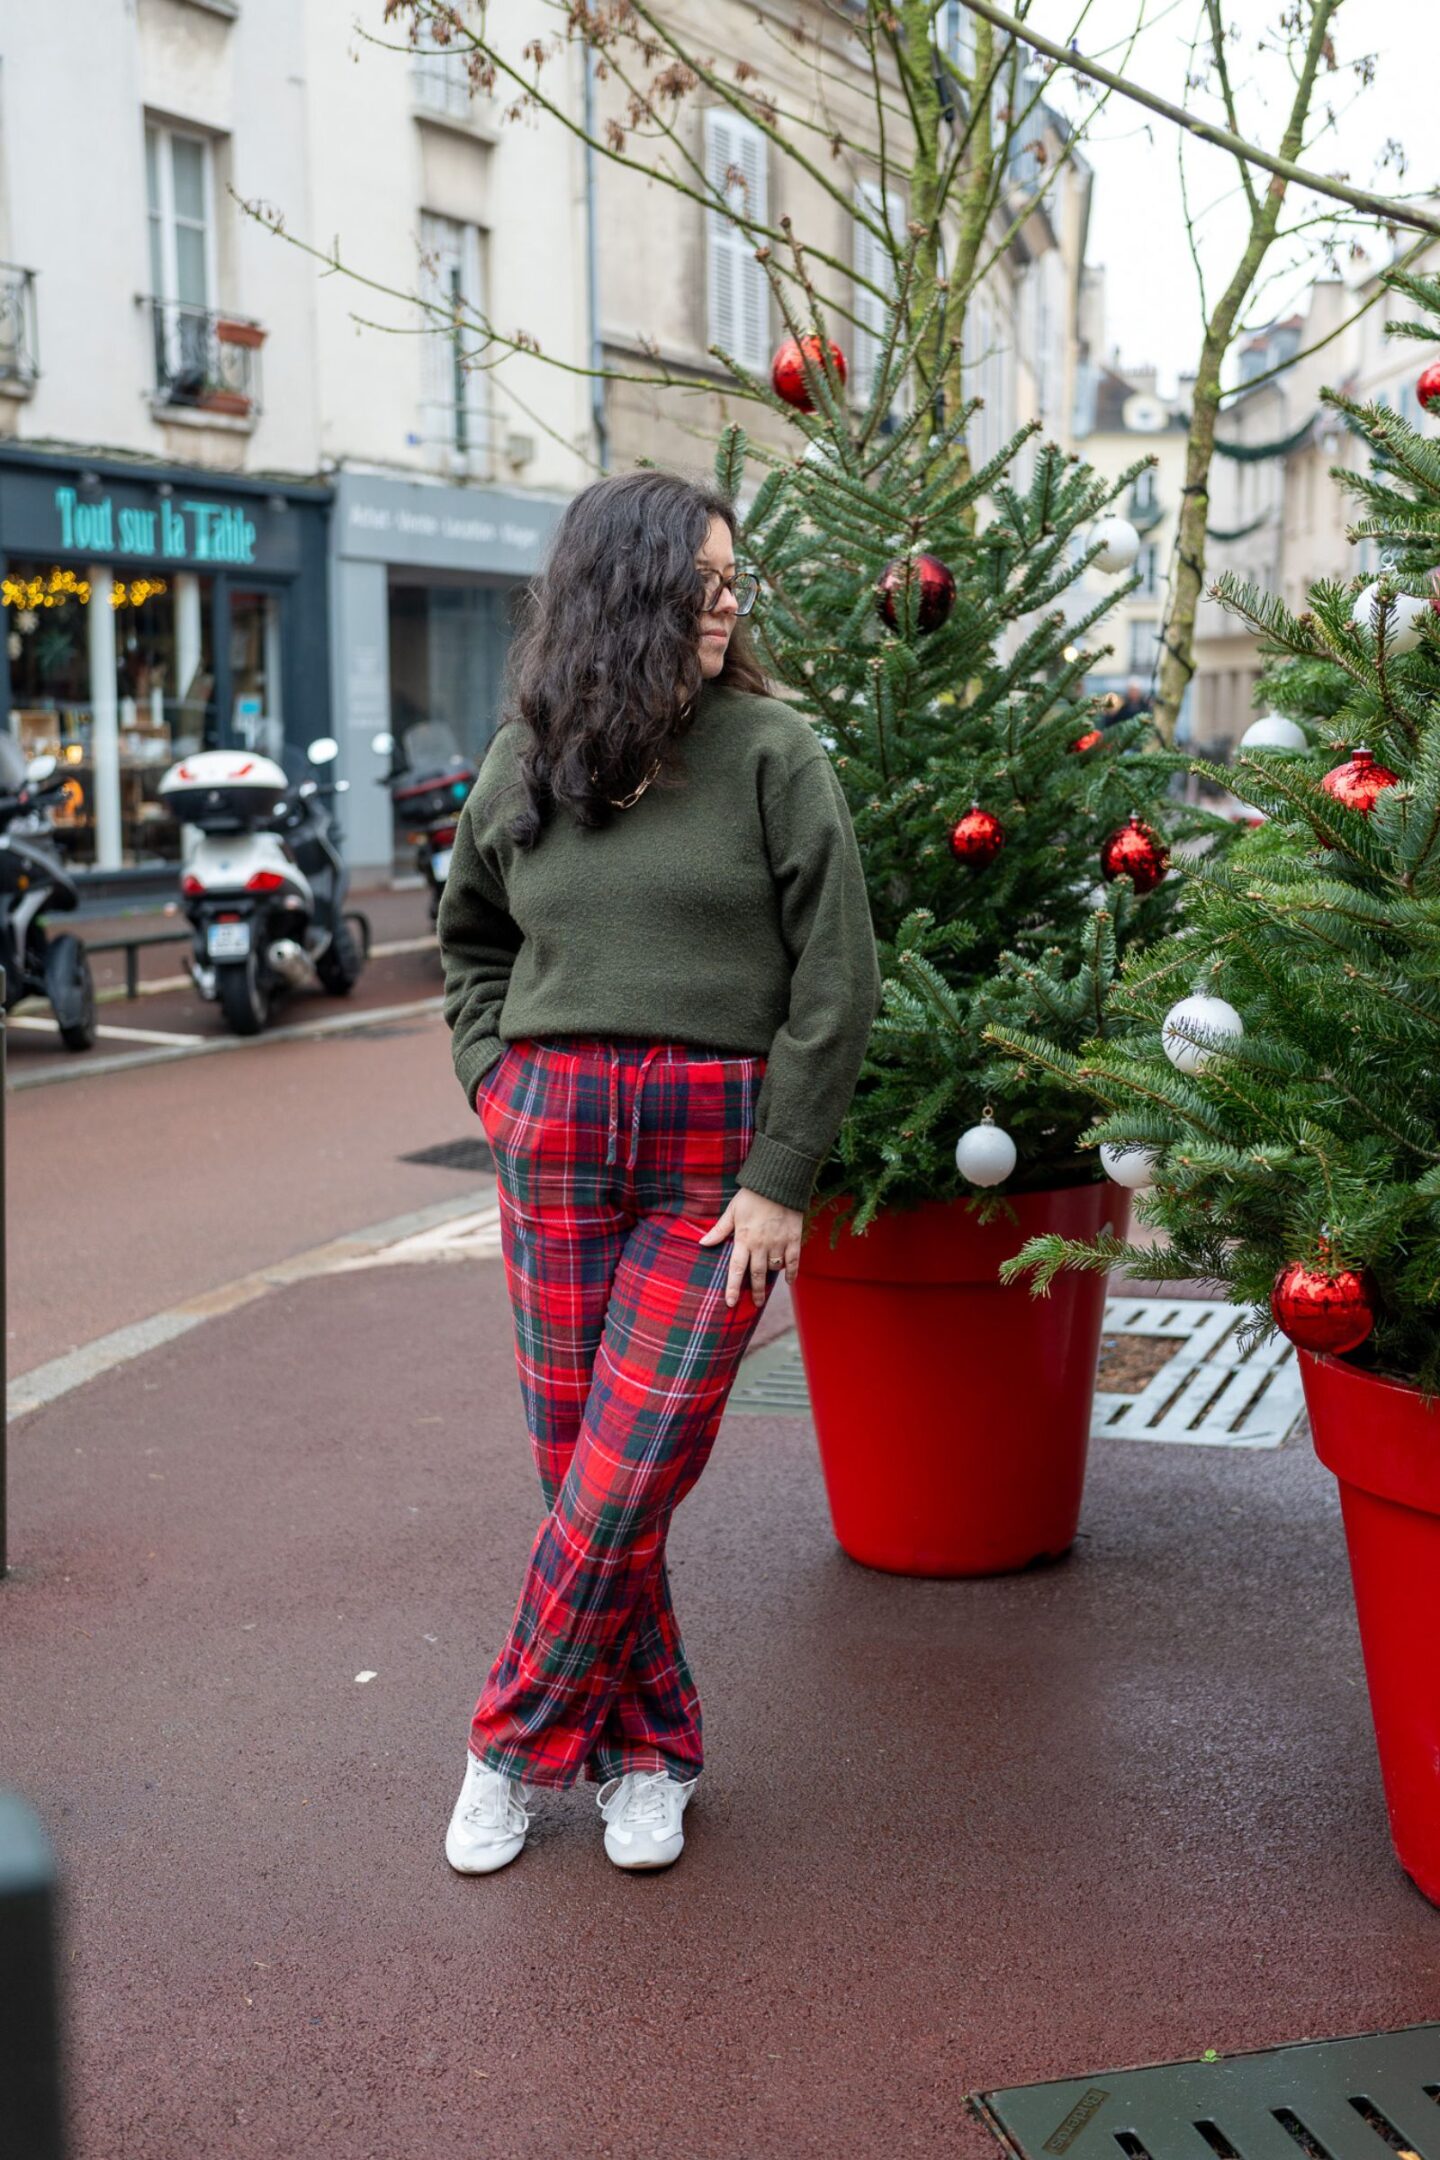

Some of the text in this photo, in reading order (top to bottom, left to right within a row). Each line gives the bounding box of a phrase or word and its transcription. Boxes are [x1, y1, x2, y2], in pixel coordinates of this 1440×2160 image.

[55, 487, 256, 564] Tout sur la Table
